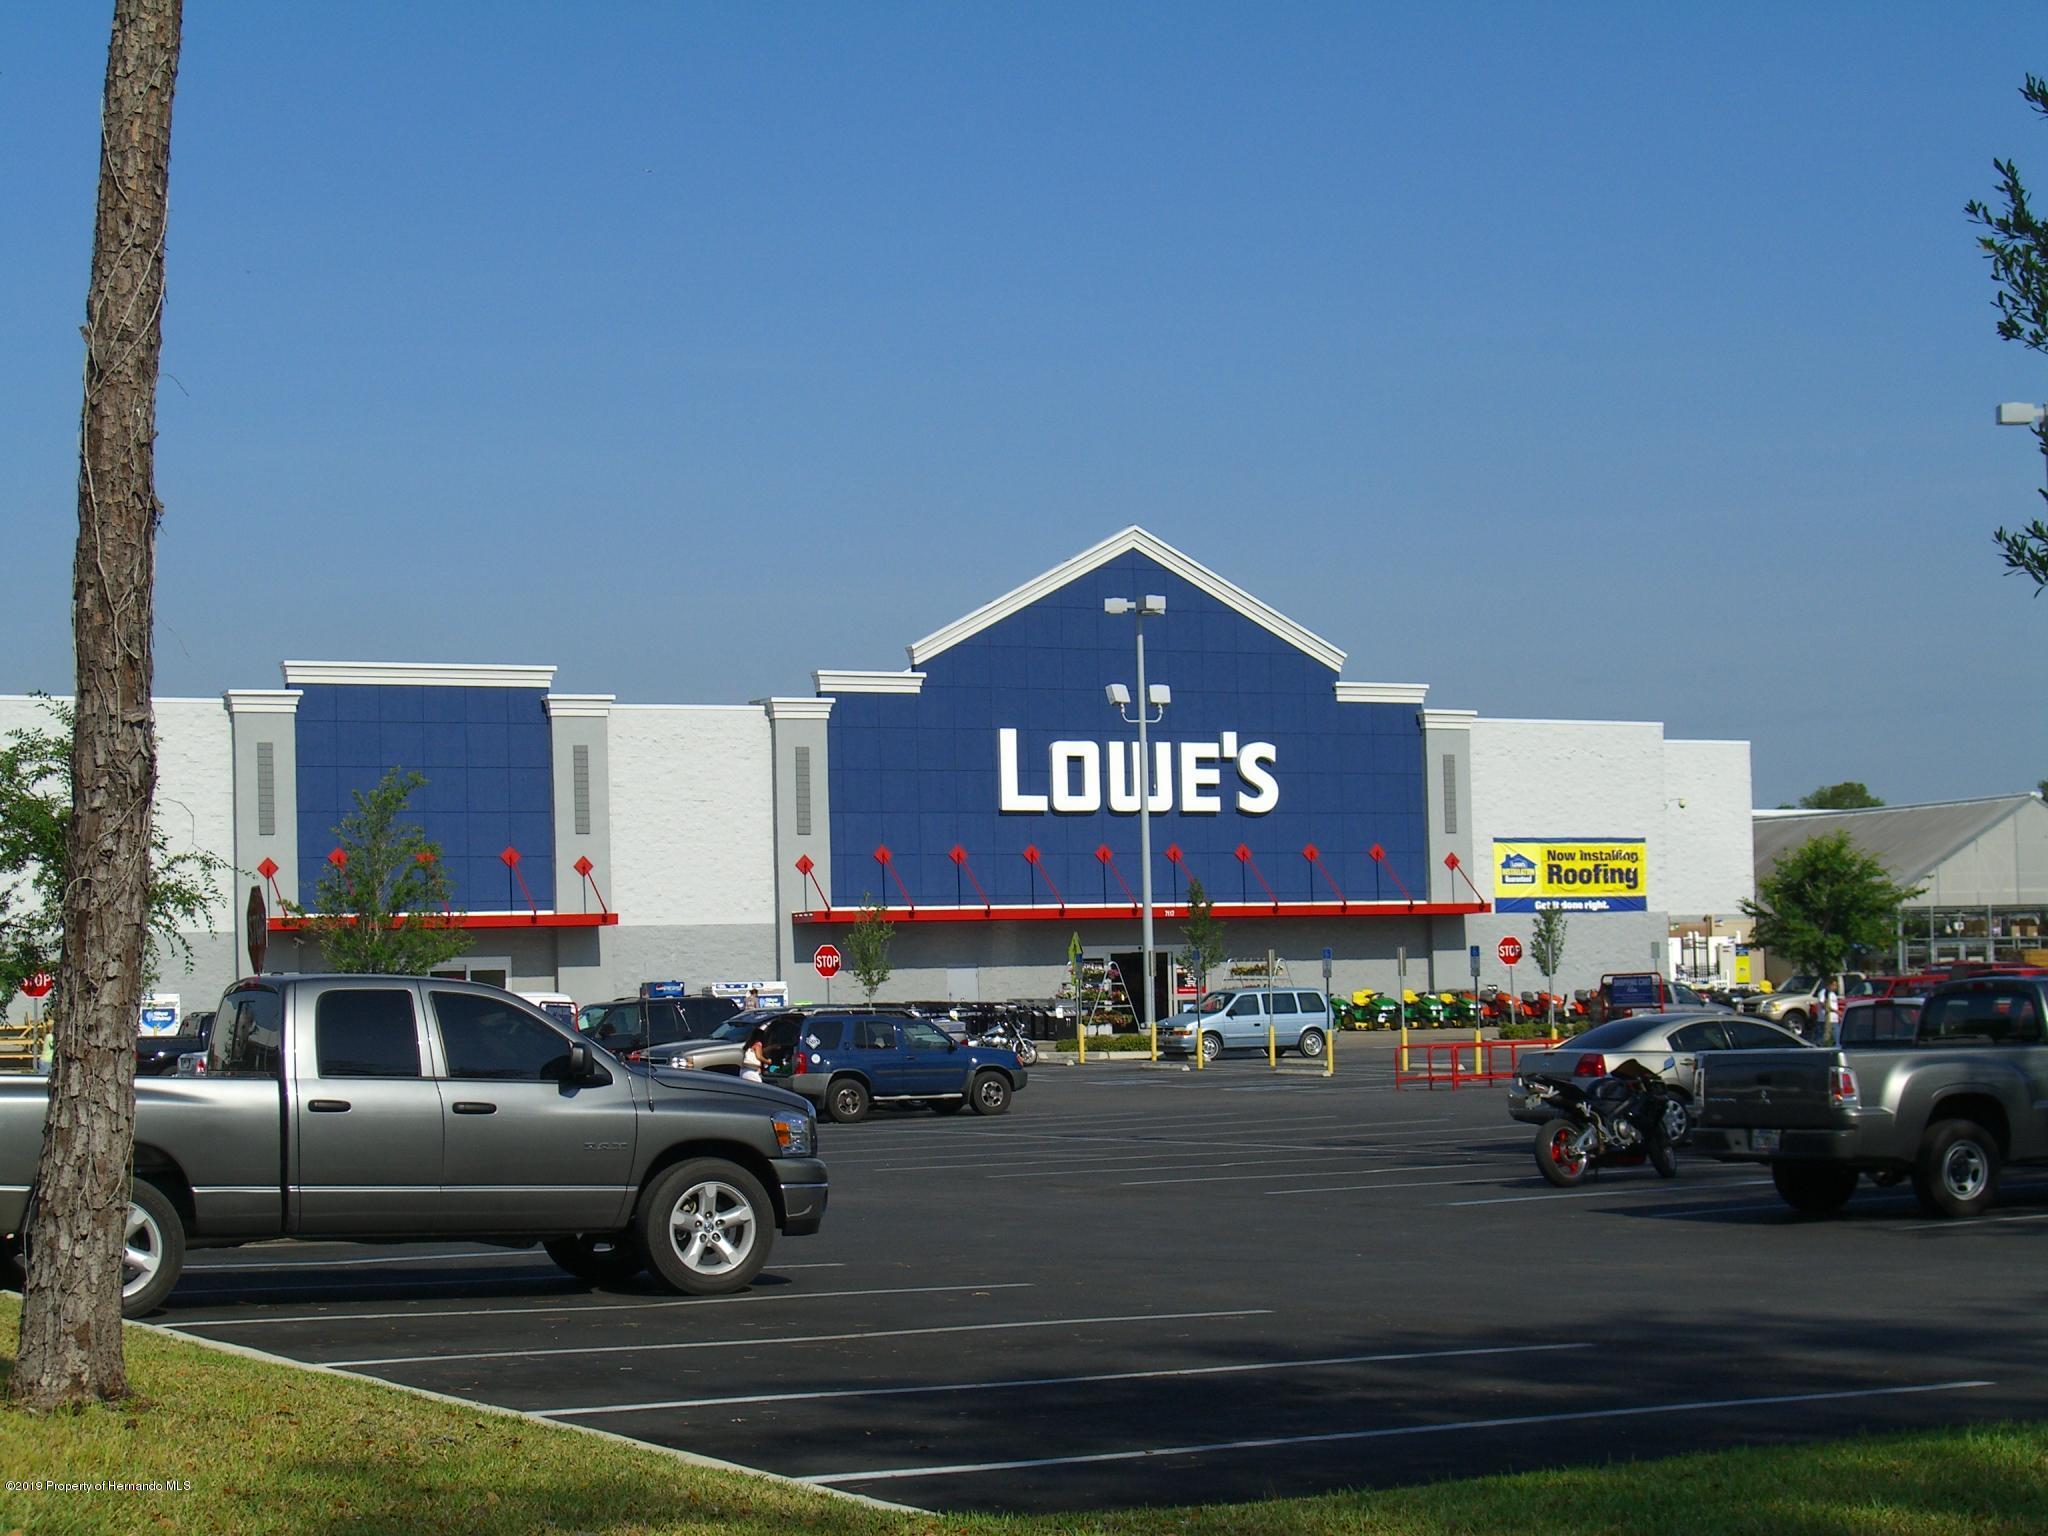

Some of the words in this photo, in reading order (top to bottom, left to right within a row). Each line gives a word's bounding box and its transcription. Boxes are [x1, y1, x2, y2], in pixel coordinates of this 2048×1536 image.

[998, 728, 1279, 813] LOWE'S
[1547, 850, 1575, 861] Now
[1547, 864, 1639, 889] Roofing
[1535, 900, 1551, 910] Get
[1561, 900, 1583, 910] done
[1584, 900, 1609, 911] right.
[1499, 945, 1520, 957] STOP
[816, 955, 839, 968] STOP
